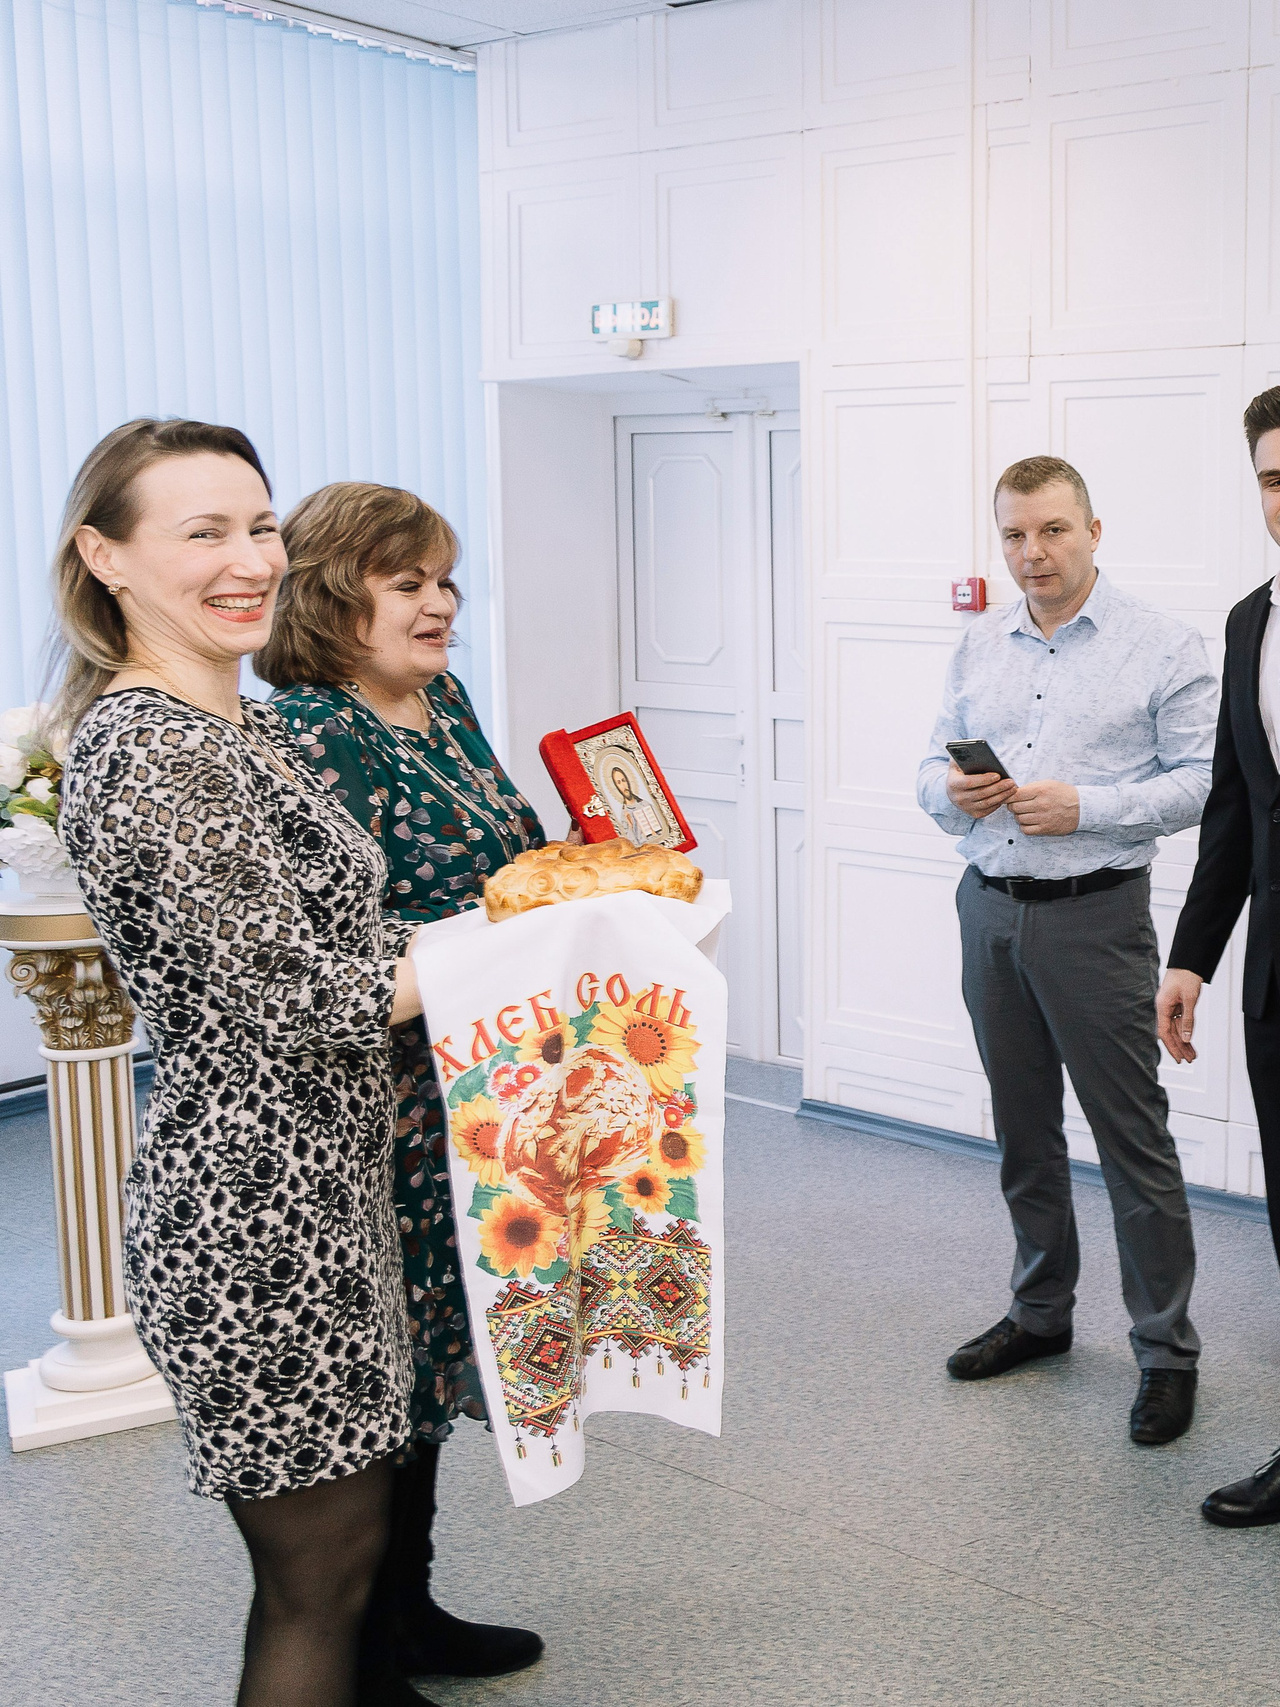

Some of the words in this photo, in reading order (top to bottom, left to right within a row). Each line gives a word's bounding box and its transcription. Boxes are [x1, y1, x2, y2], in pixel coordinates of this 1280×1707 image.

[594, 307, 665, 328] ВОД
[433, 989, 562, 1082] ХЛЕБ
[576, 972, 692, 1029] СОЛЬ
